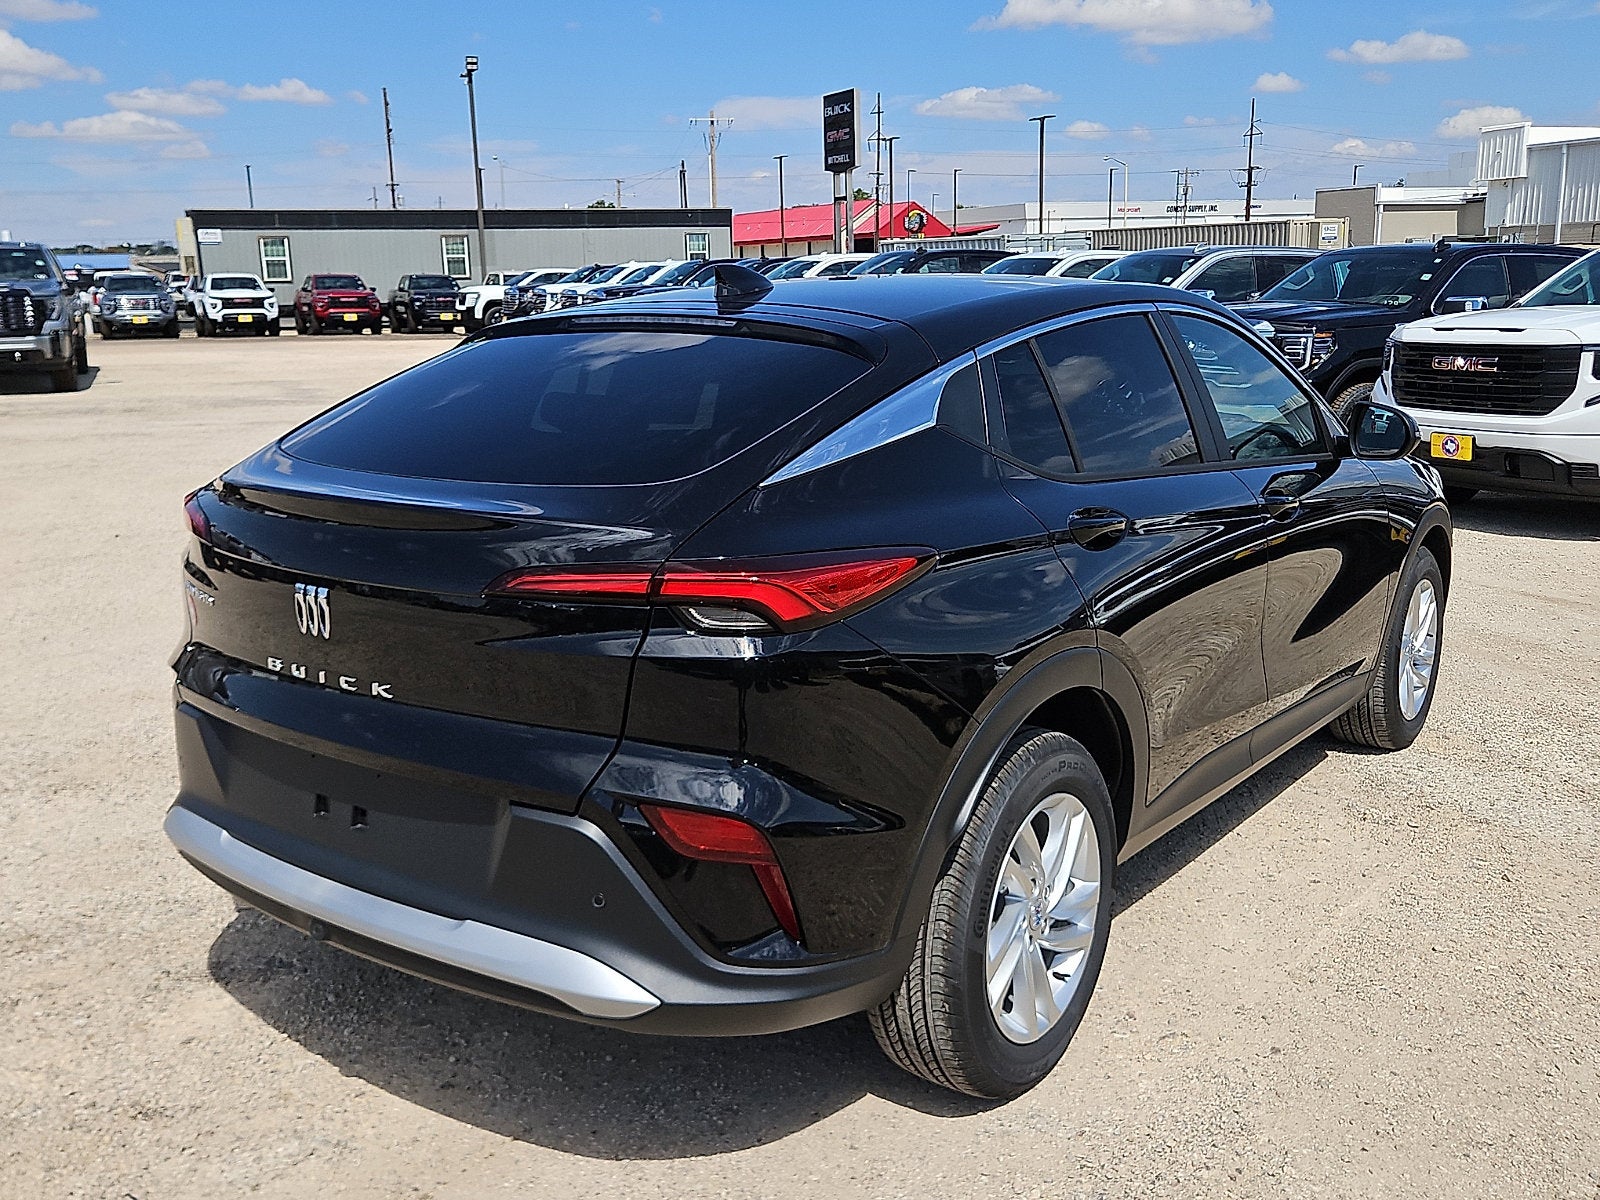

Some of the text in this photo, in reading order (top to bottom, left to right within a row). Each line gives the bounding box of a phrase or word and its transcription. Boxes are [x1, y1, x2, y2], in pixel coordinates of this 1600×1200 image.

[825, 102, 851, 117] BUICK
[826, 128, 850, 143] GMC
[1432, 355, 1499, 372] GMC
[267, 656, 394, 699] BUICK
